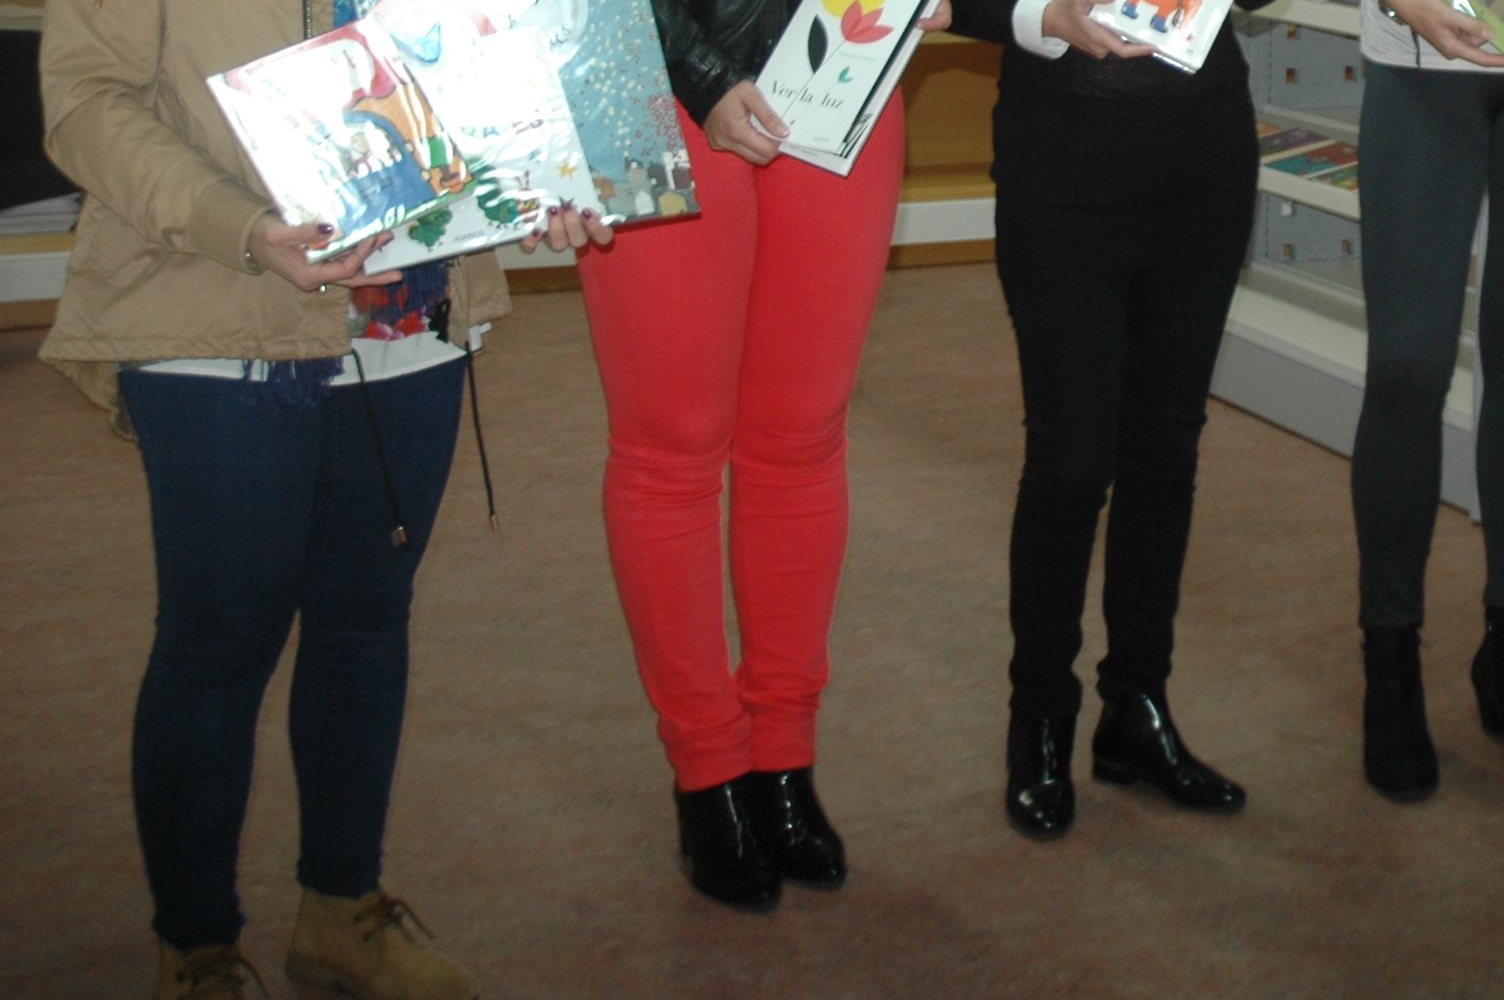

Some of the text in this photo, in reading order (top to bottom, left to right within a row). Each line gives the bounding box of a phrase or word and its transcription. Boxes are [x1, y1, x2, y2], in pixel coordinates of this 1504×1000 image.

[772, 80, 845, 108] Ver la luz
